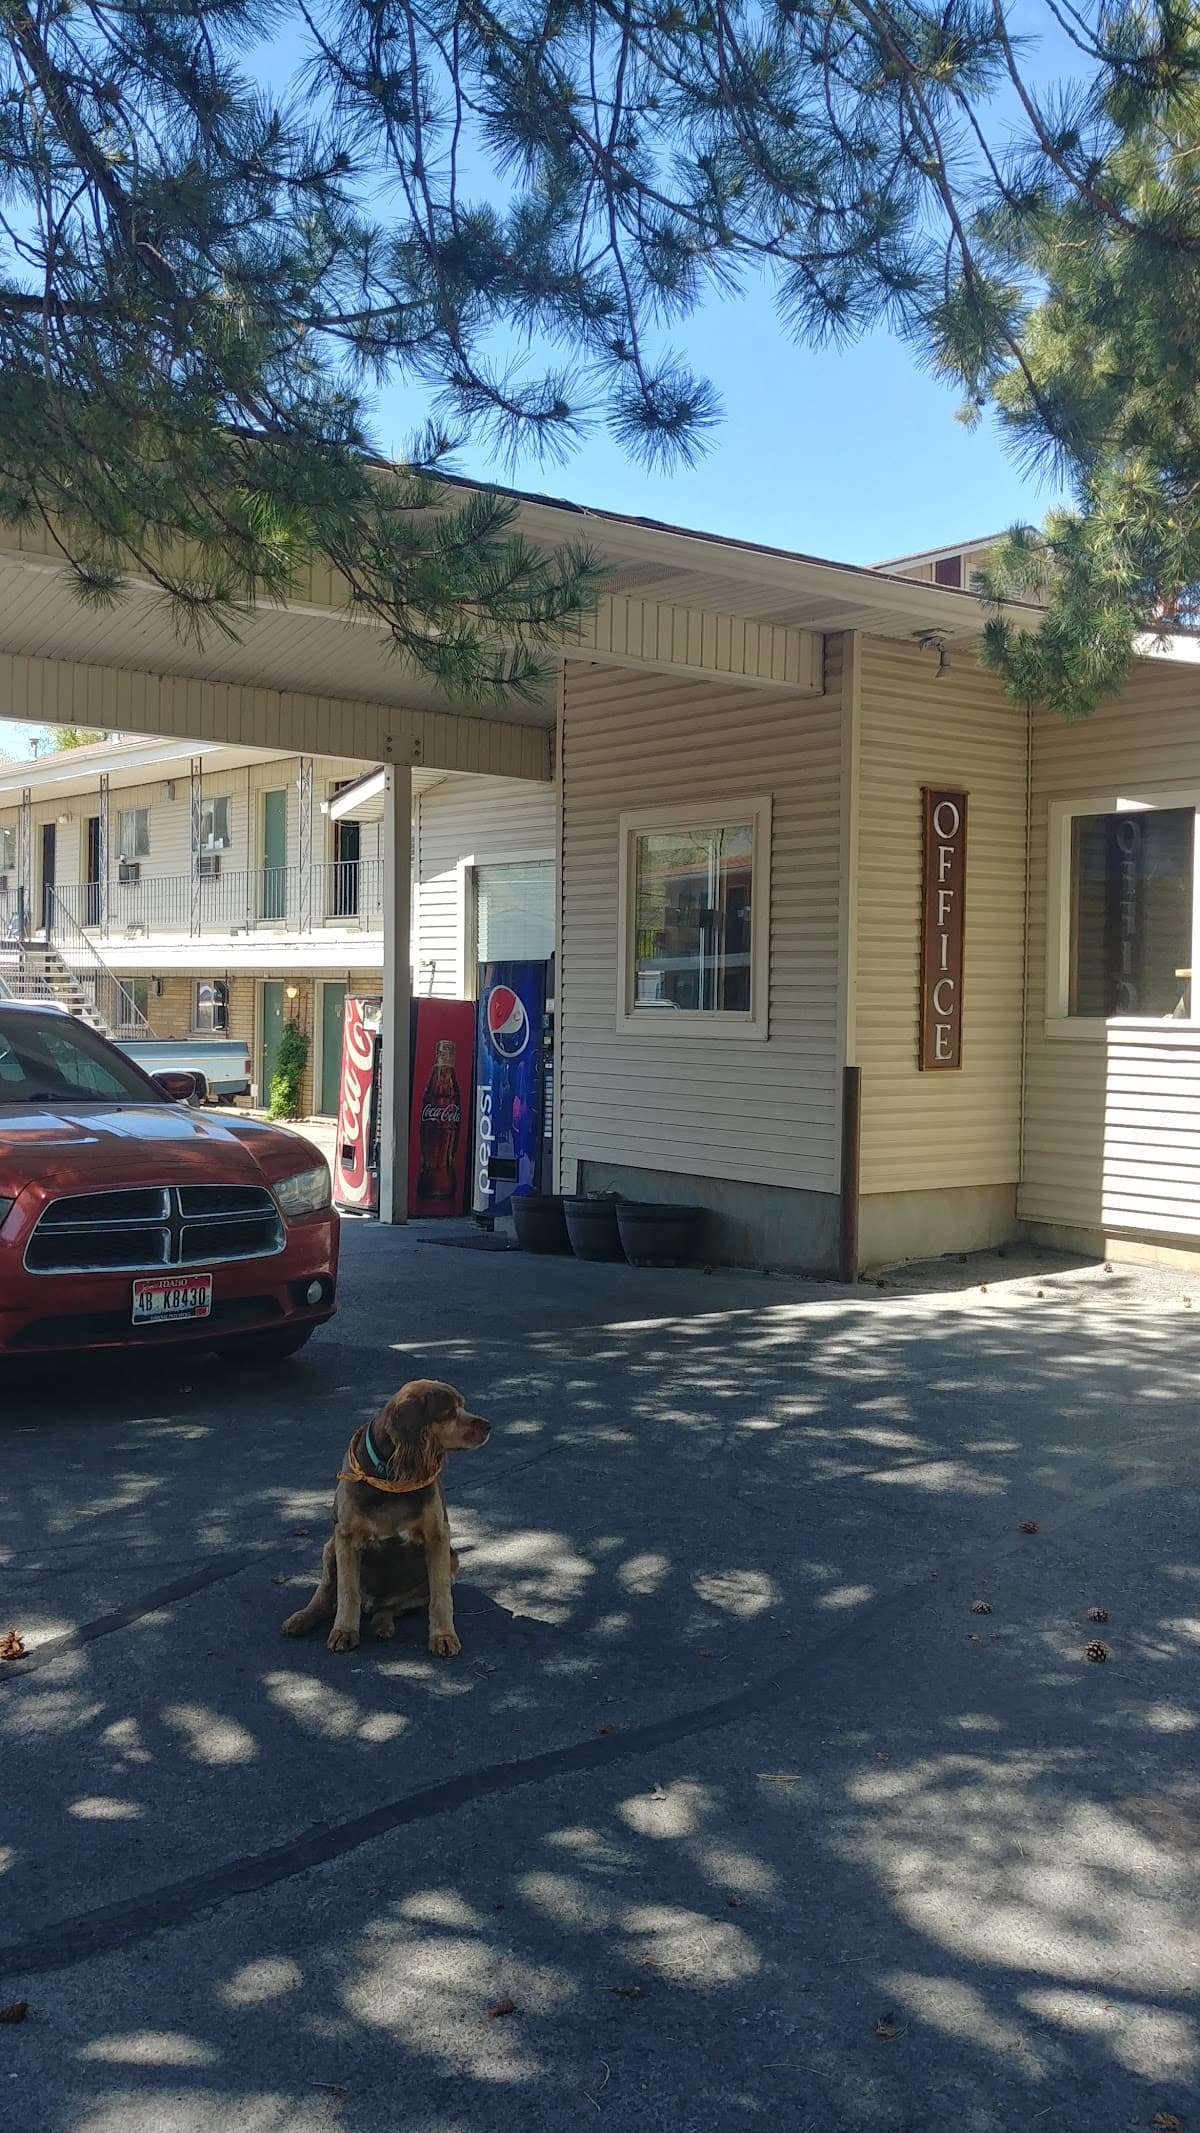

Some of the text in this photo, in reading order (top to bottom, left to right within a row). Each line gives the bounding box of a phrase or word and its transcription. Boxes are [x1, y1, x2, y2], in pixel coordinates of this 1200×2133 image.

[933, 801, 960, 1060] OFFICE
[159, 1279, 187, 1288] IDAHO
[138, 1292, 153, 1312] 4B
[163, 1287, 206, 1309] K8430
